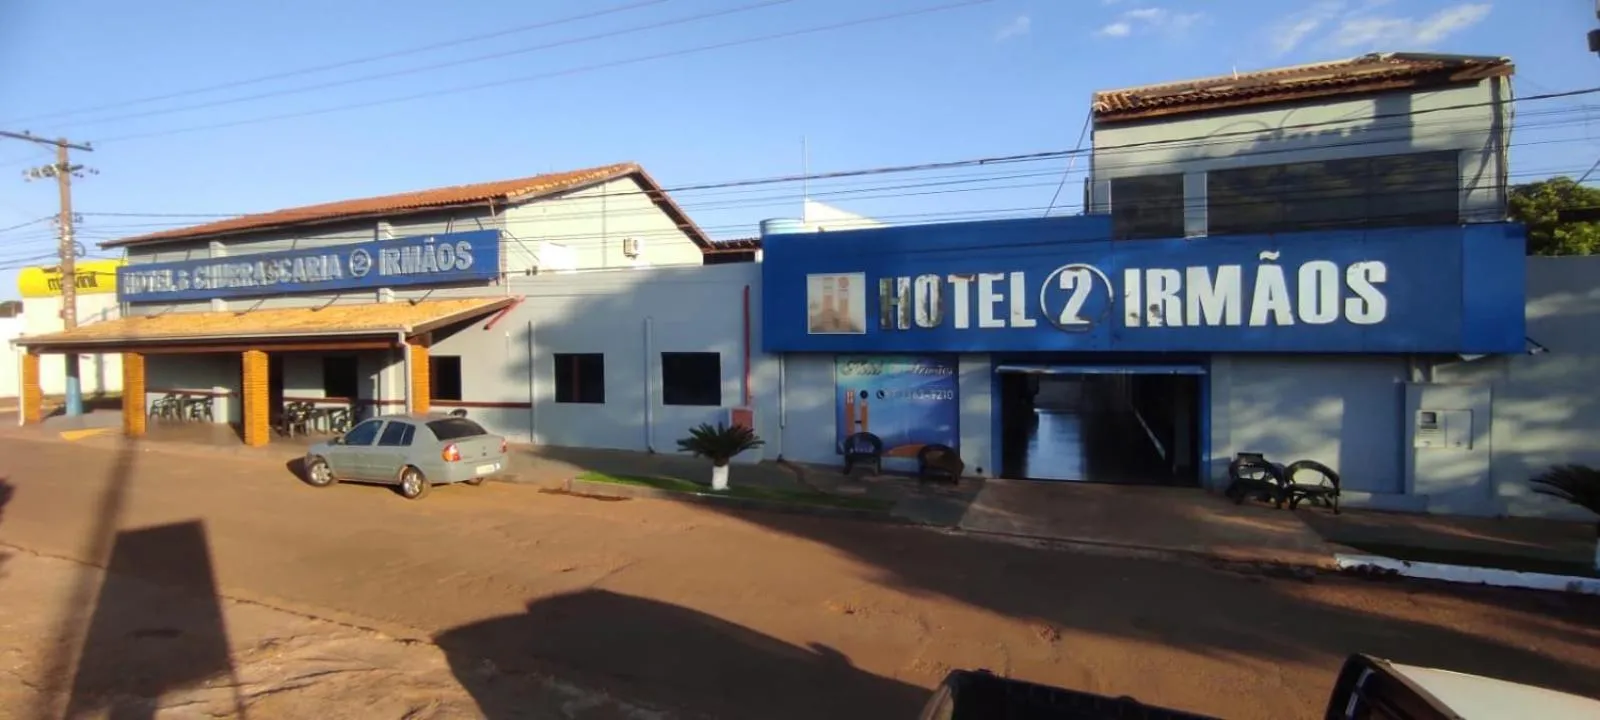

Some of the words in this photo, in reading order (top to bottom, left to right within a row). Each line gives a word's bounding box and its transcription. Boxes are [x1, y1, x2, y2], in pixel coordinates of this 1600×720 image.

[123, 269, 178, 294] HOTEL
[191, 254, 343, 290] CHURRASCARIA
[378, 237, 474, 276] IRMÃOS
[879, 271, 1037, 330] HOTEL
[1124, 250, 1387, 327] IRMÃOS
